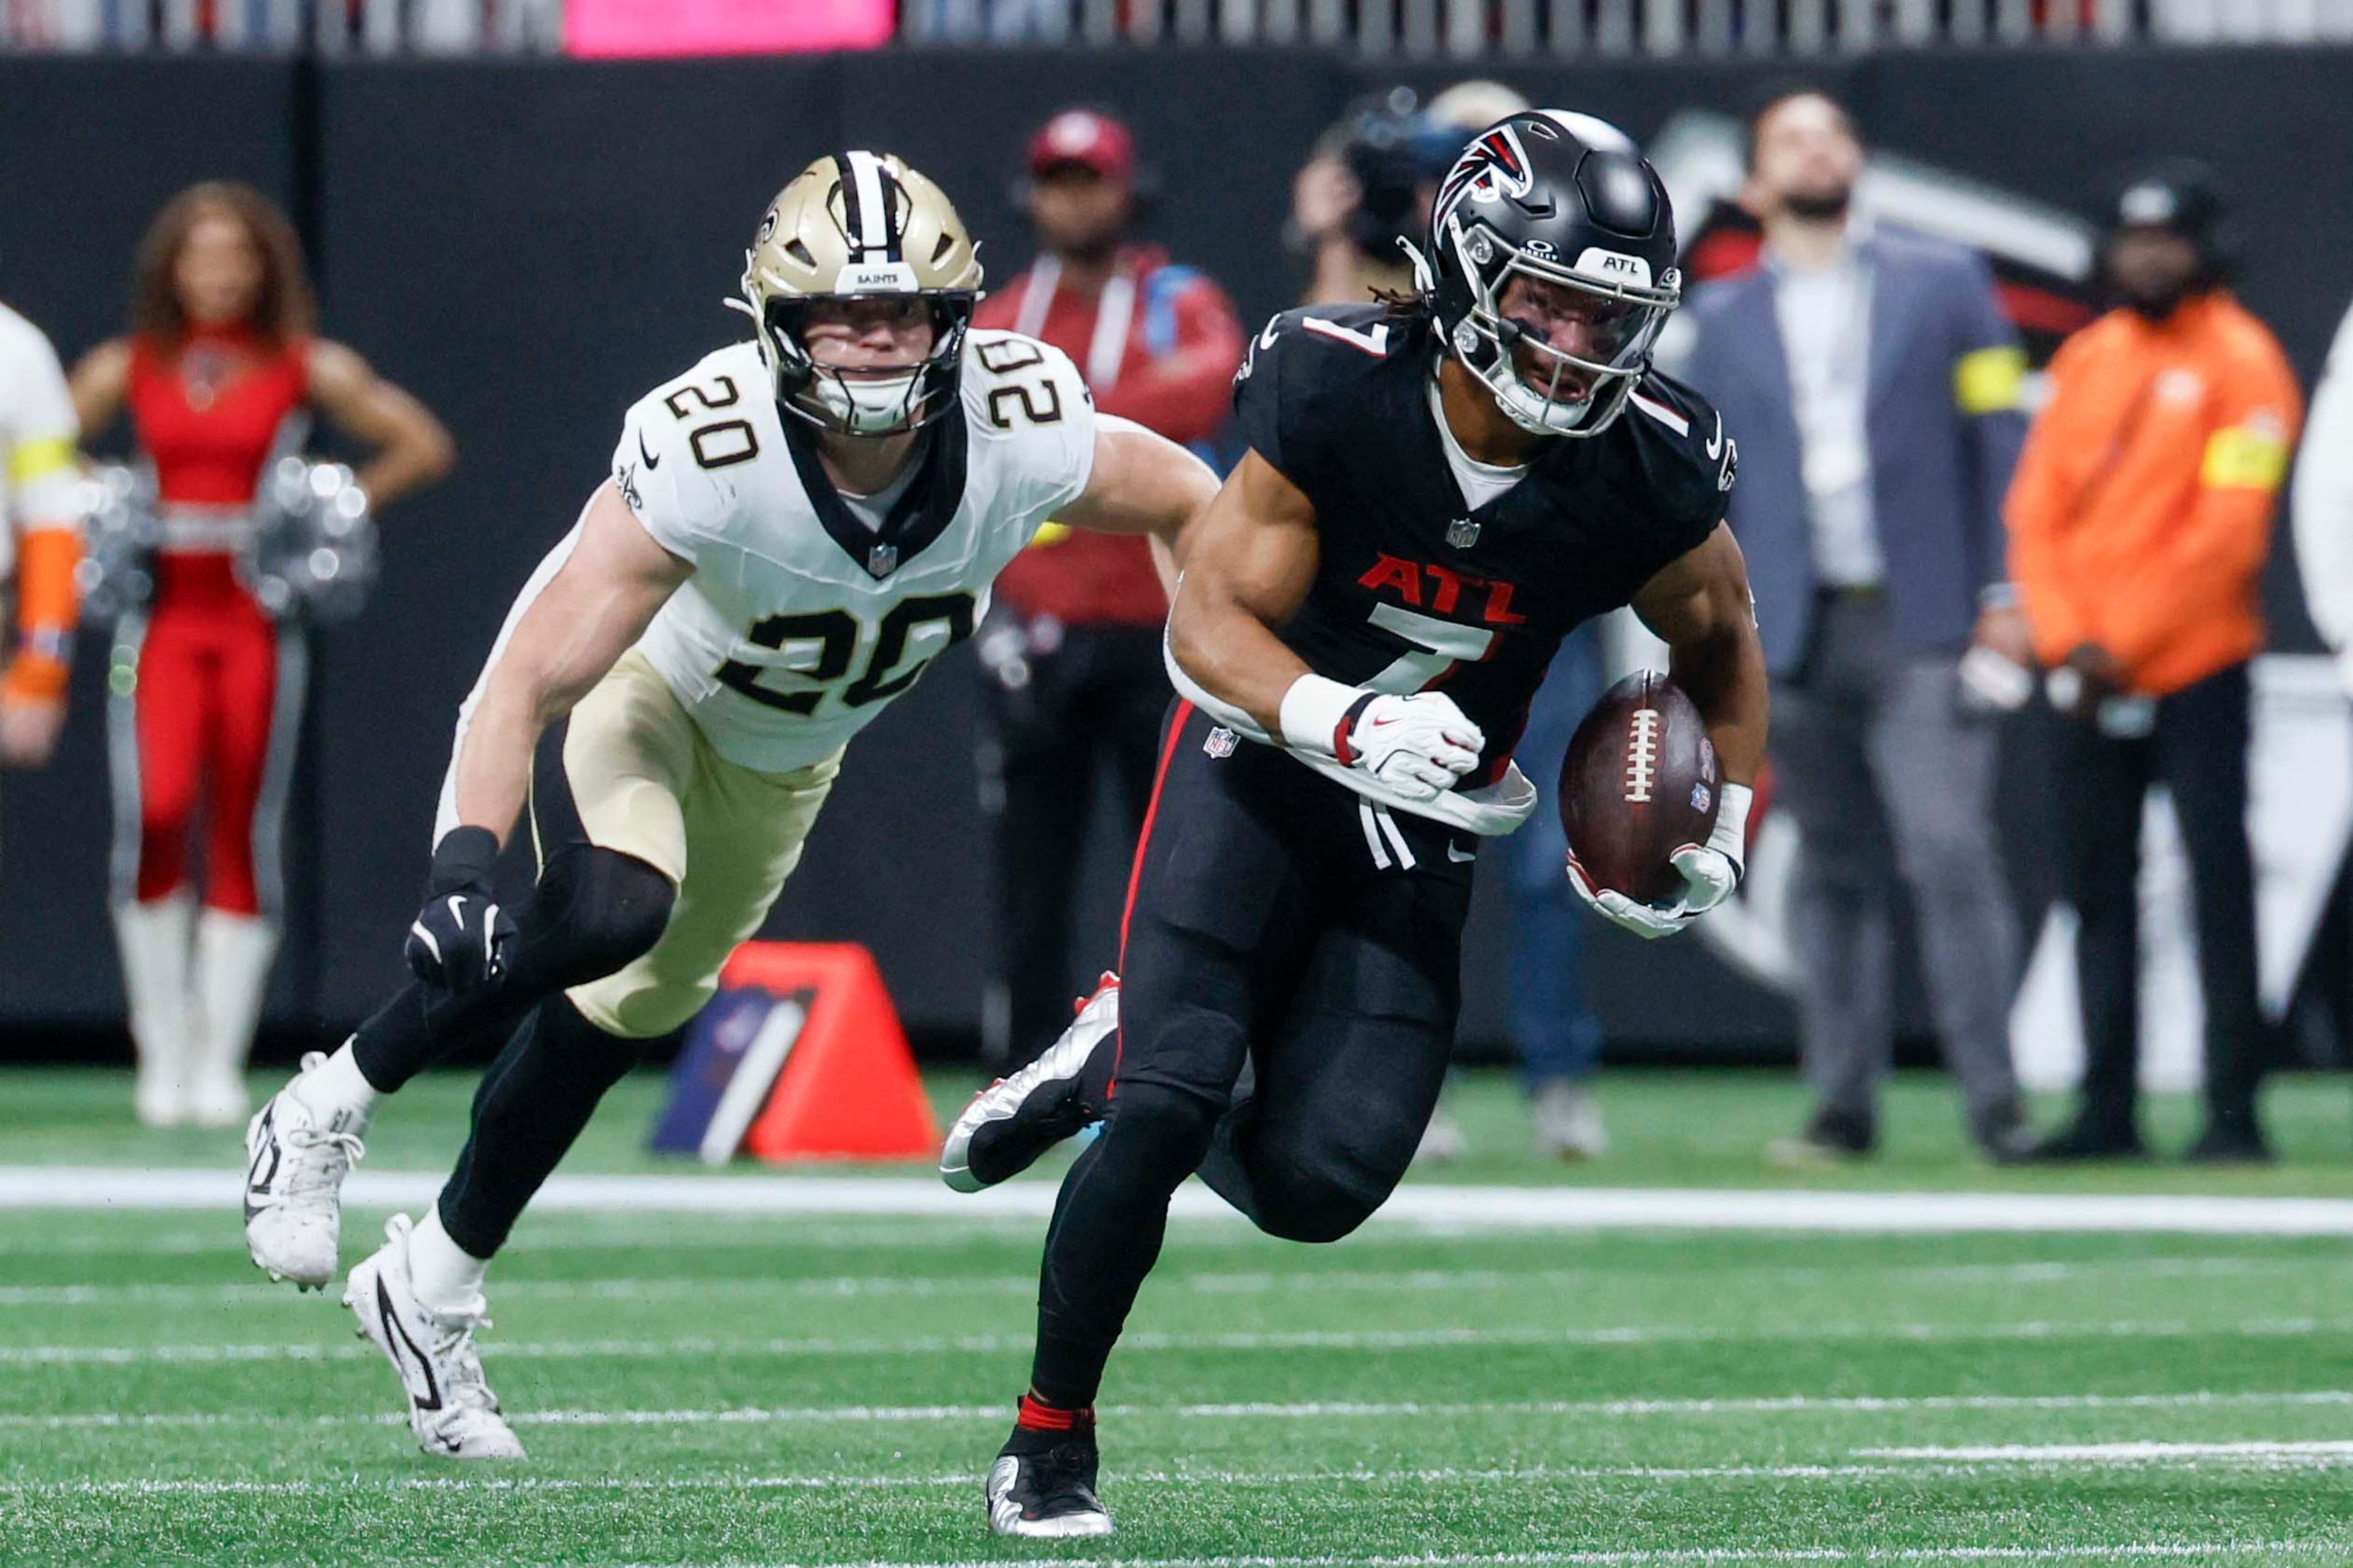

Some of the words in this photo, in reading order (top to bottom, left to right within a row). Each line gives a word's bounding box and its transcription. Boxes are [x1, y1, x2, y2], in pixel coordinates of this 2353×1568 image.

[857, 273, 898, 284] SAINTS
[1603, 256, 1638, 274] ATL
[664, 376, 759, 470] 20
[974, 339, 1063, 428] 20
[1358, 553, 1528, 624] ATL
[714, 592, 976, 716] 20
[1355, 601, 1501, 696] 7
